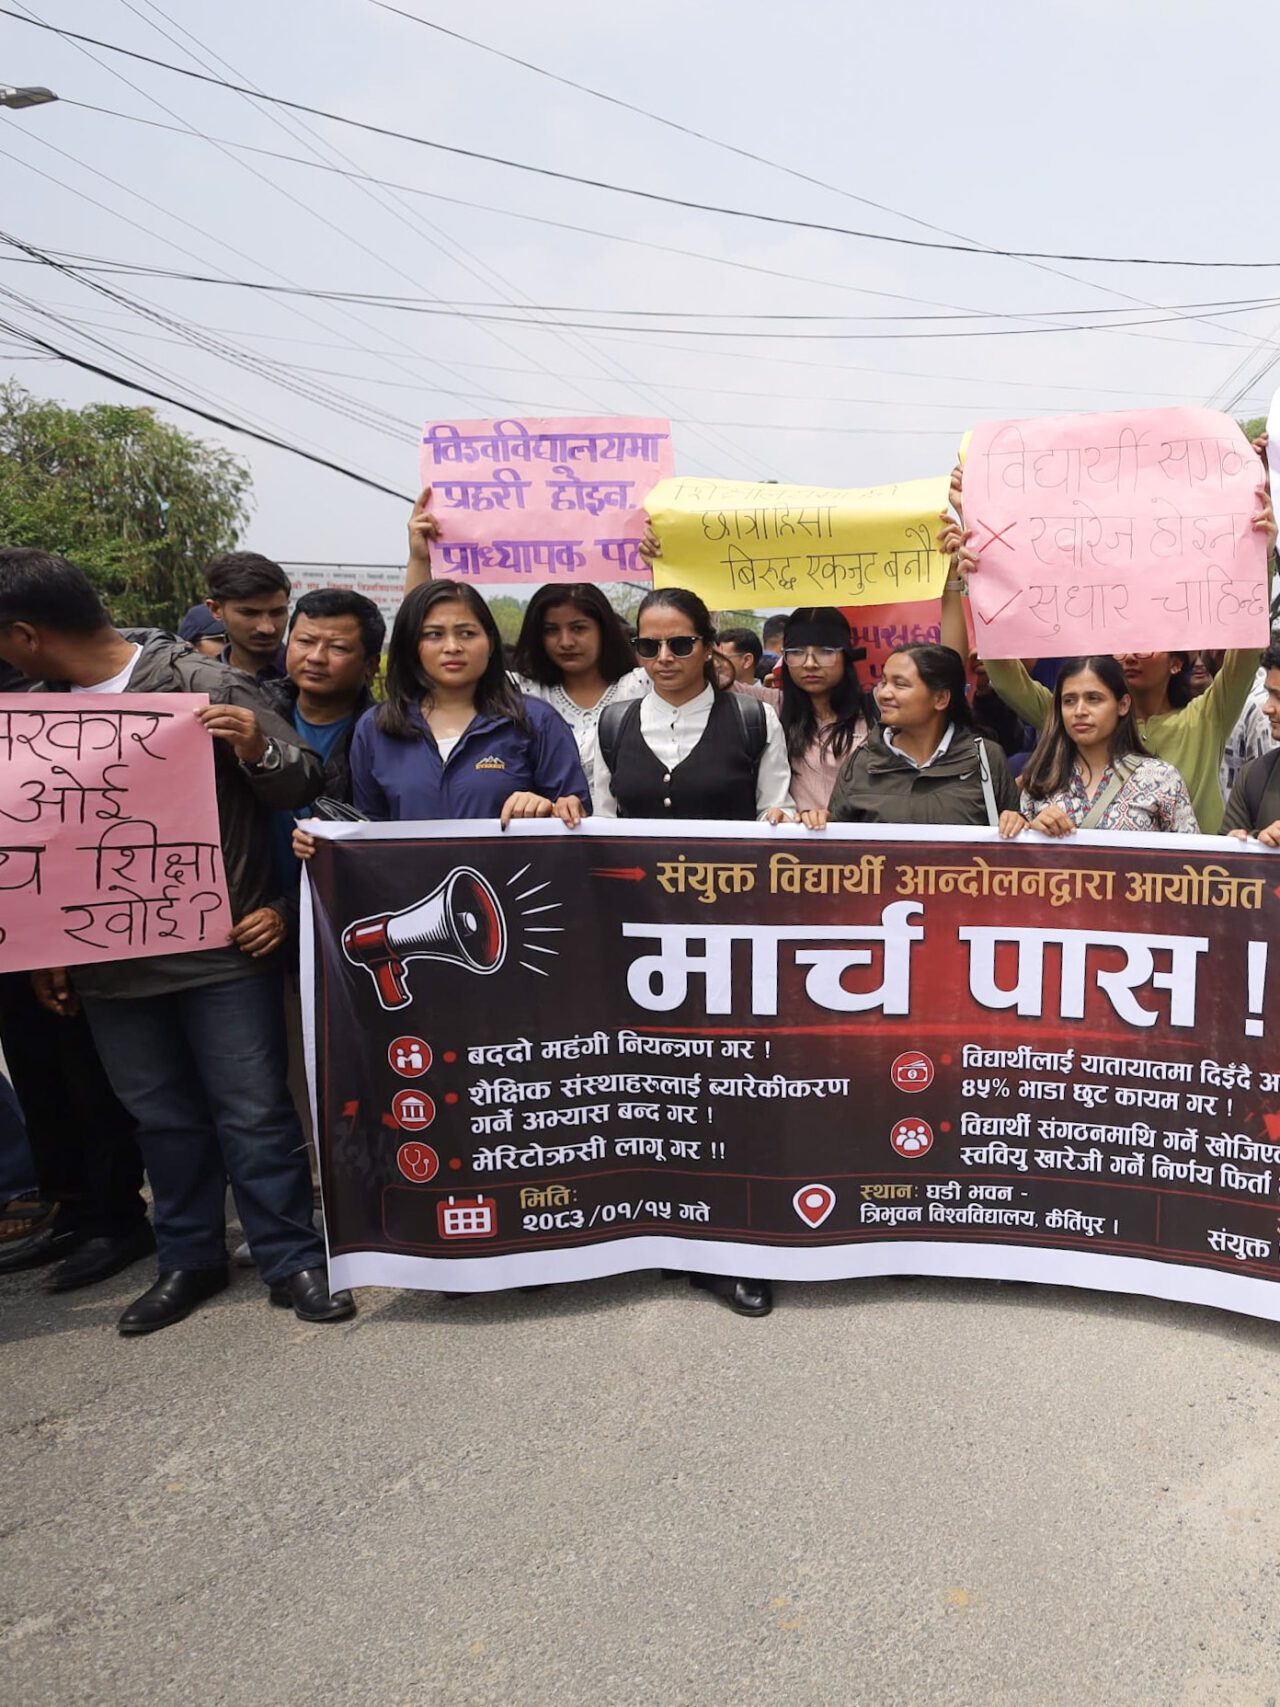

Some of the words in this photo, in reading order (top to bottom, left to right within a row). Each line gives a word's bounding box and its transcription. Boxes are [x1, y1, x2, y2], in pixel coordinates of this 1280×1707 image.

[432, 467, 532, 511] प्रहरी
[434, 540, 586, 575] प्राध्यापक
[1029, 583, 1129, 638] सुधार
[657, 861, 757, 903] संयुक्त
[769, 855, 885, 894] विद्यार्थी
[896, 856, 1114, 906] आन्दोलनद्वारा
[1126, 865, 1266, 909] आयोजित
[621, 900, 923, 1017] मार्च
[958, 925, 1208, 1028] पास
[541, 1031, 610, 1060] महंगी
[618, 1029, 714, 1058] नियन्त्रण
[721, 1040, 755, 1058] गर
[962, 1043, 1075, 1074] विद्यार्थीलाई
[1081, 1054, 1194, 1083] यातायातमा
[468, 1077, 552, 1106] शैक्षिक
[1018, 1079, 1067, 1100] भाडा
[1073, 1082, 1109, 1109] छुट
[1115, 1086, 1180, 1112] कायम
[1186, 1093, 1219, 1117] गर
[470, 1108, 514, 1134] गर्ने
[522, 1103, 610, 1131] अभ्यास
[617, 1102, 660, 1121] बन्द
[666, 1104, 698, 1124] गर
[960, 1111, 1031, 1138] विद्यार्थी
[1037, 1116, 1157, 1149] संगठनमाथि
[1163, 1127, 1199, 1154] गर्ने
[614, 1137, 668, 1161] लागू
[669, 1139, 701, 1160] गर
[960, 1141, 1028, 1172] स्ववियु
[1034, 1145, 1103, 1173] खारेजी
[1110, 1152, 1145, 1177] गर्ने
[1152, 1154, 1214, 1185] निर्णय
[1220, 1163, 1272, 1195] फिर्ता
[926, 1180, 962, 1201] घडी
[968, 1185, 1014, 1201] भवन
[679, 1200, 711, 1223] गते
[860, 1204, 922, 1226] त्रिभुवन
[1207, 1228, 1272, 1261] संयुक्त
